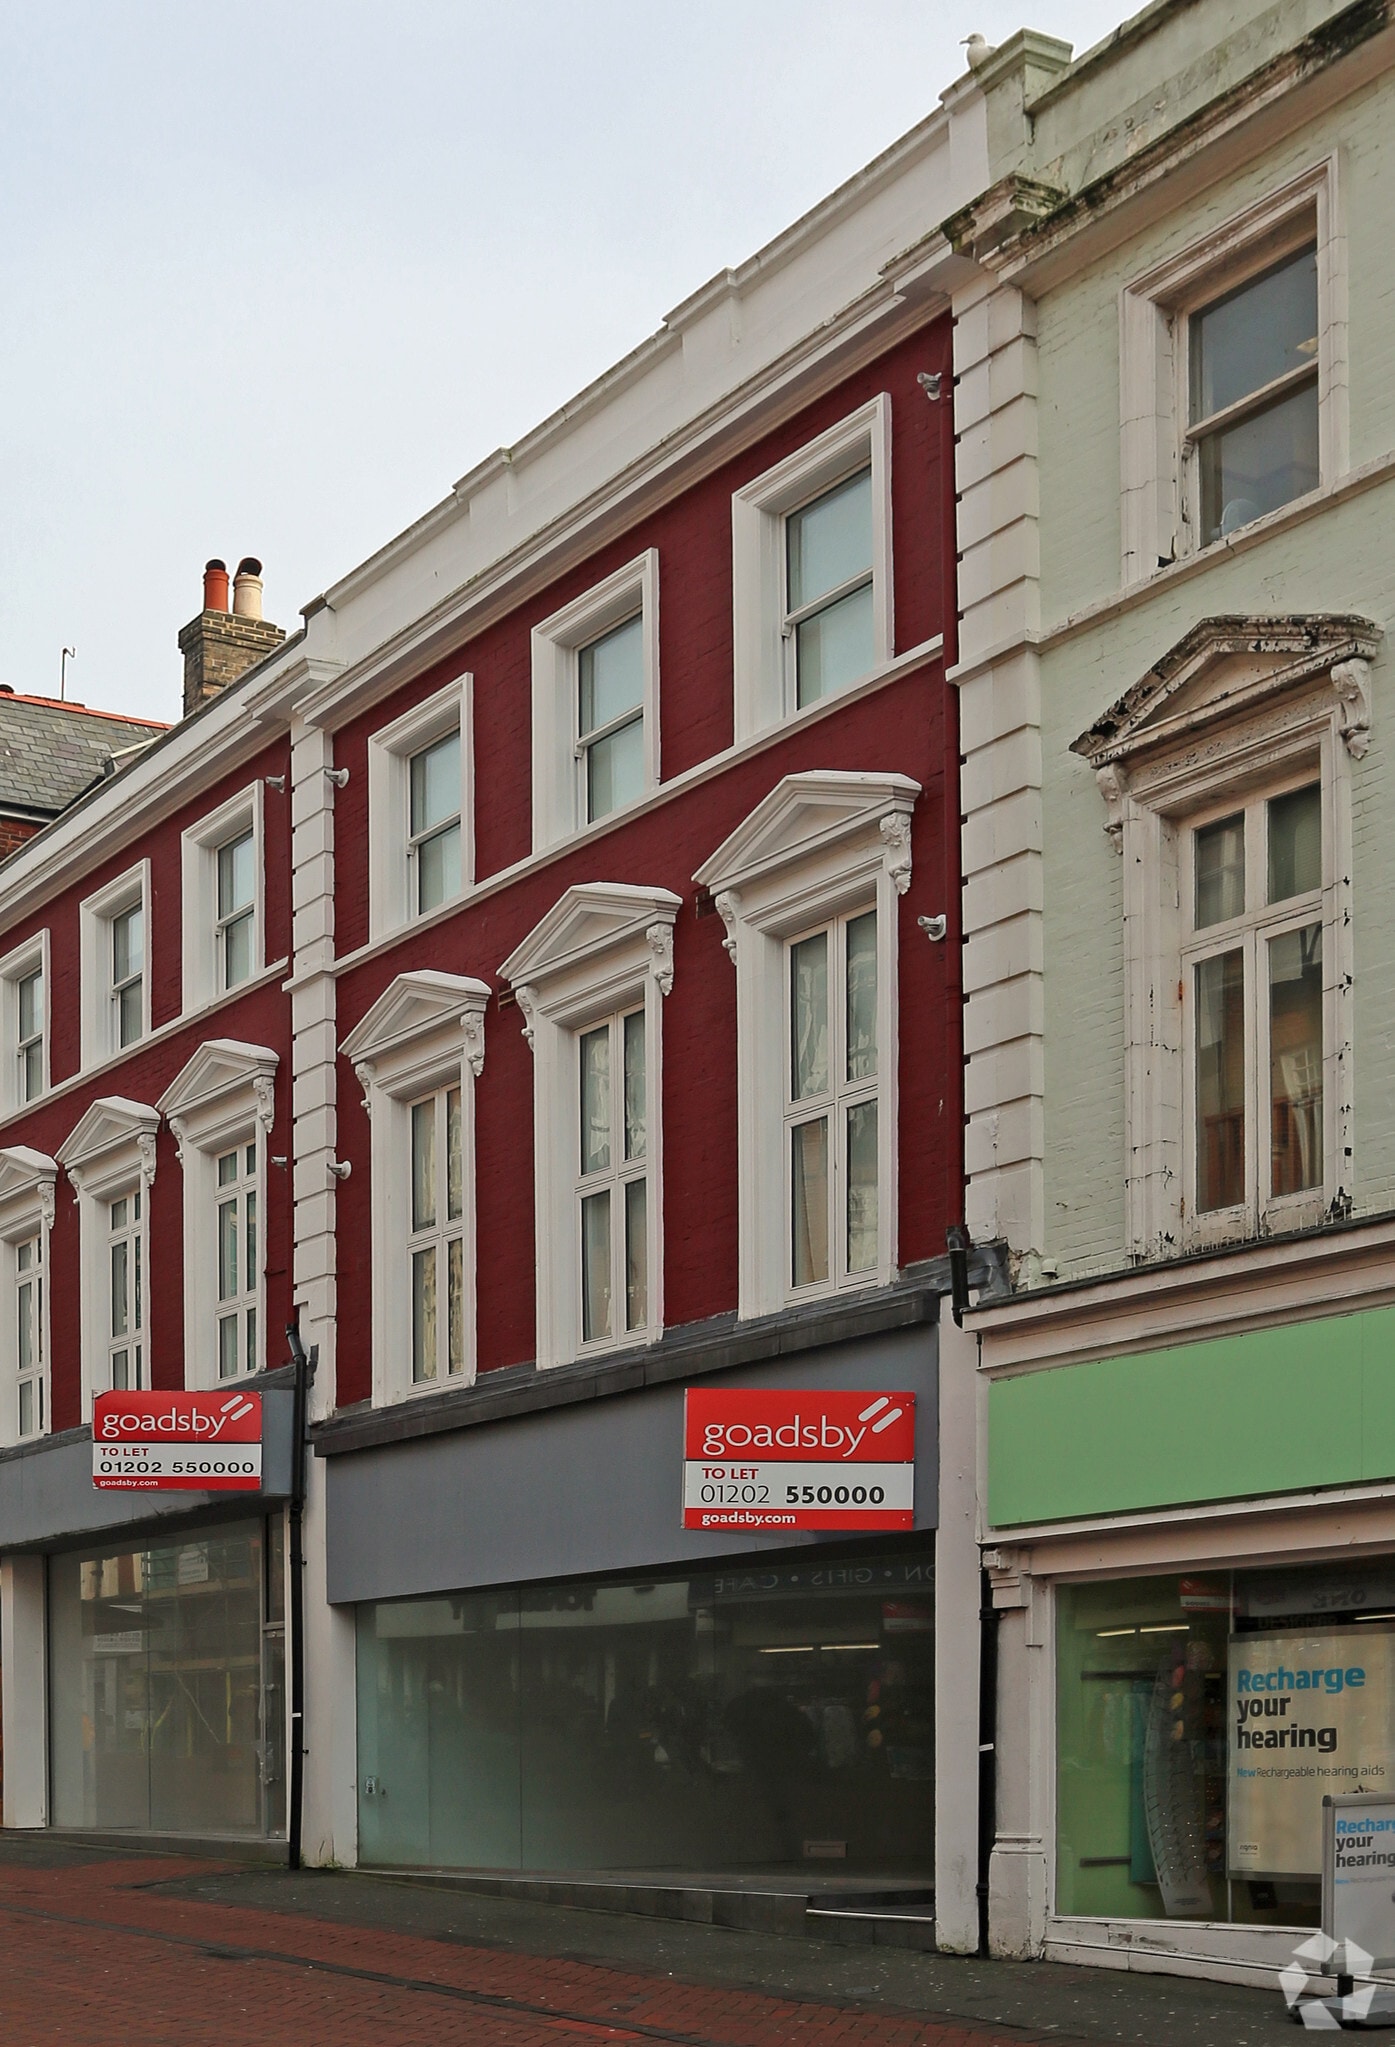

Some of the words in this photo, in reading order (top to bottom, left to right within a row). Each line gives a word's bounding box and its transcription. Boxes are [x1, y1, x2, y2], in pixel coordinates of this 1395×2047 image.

[101, 1407, 227, 1439] goadsby
[702, 1414, 867, 1457] goadsby
[100, 1447, 119, 1457] TO
[123, 1447, 149, 1457] LET
[100, 1461, 162, 1473] 01202
[172, 1462, 255, 1474] 550000
[702, 1467, 726, 1480] TO
[731, 1468, 759, 1480] LET
[99, 1479, 159, 1487] goadsby.com
[700, 1485, 770, 1504] 01202
[786, 1486, 885, 1505] 550000
[701, 1511, 796, 1526] goadsby.com
[1237, 1666, 1366, 1694] Recharge
[1237, 1697, 1291, 1724] your
[1237, 1723, 1338, 1753] hearing
[1237, 1767, 1256, 1777] New
[1256, 1766, 1316, 1779] Rechargeable
[1317, 1765, 1359, 1779] hearing
[1360, 1764, 1385, 1776] aids
[1336, 1836, 1374, 1852] your
